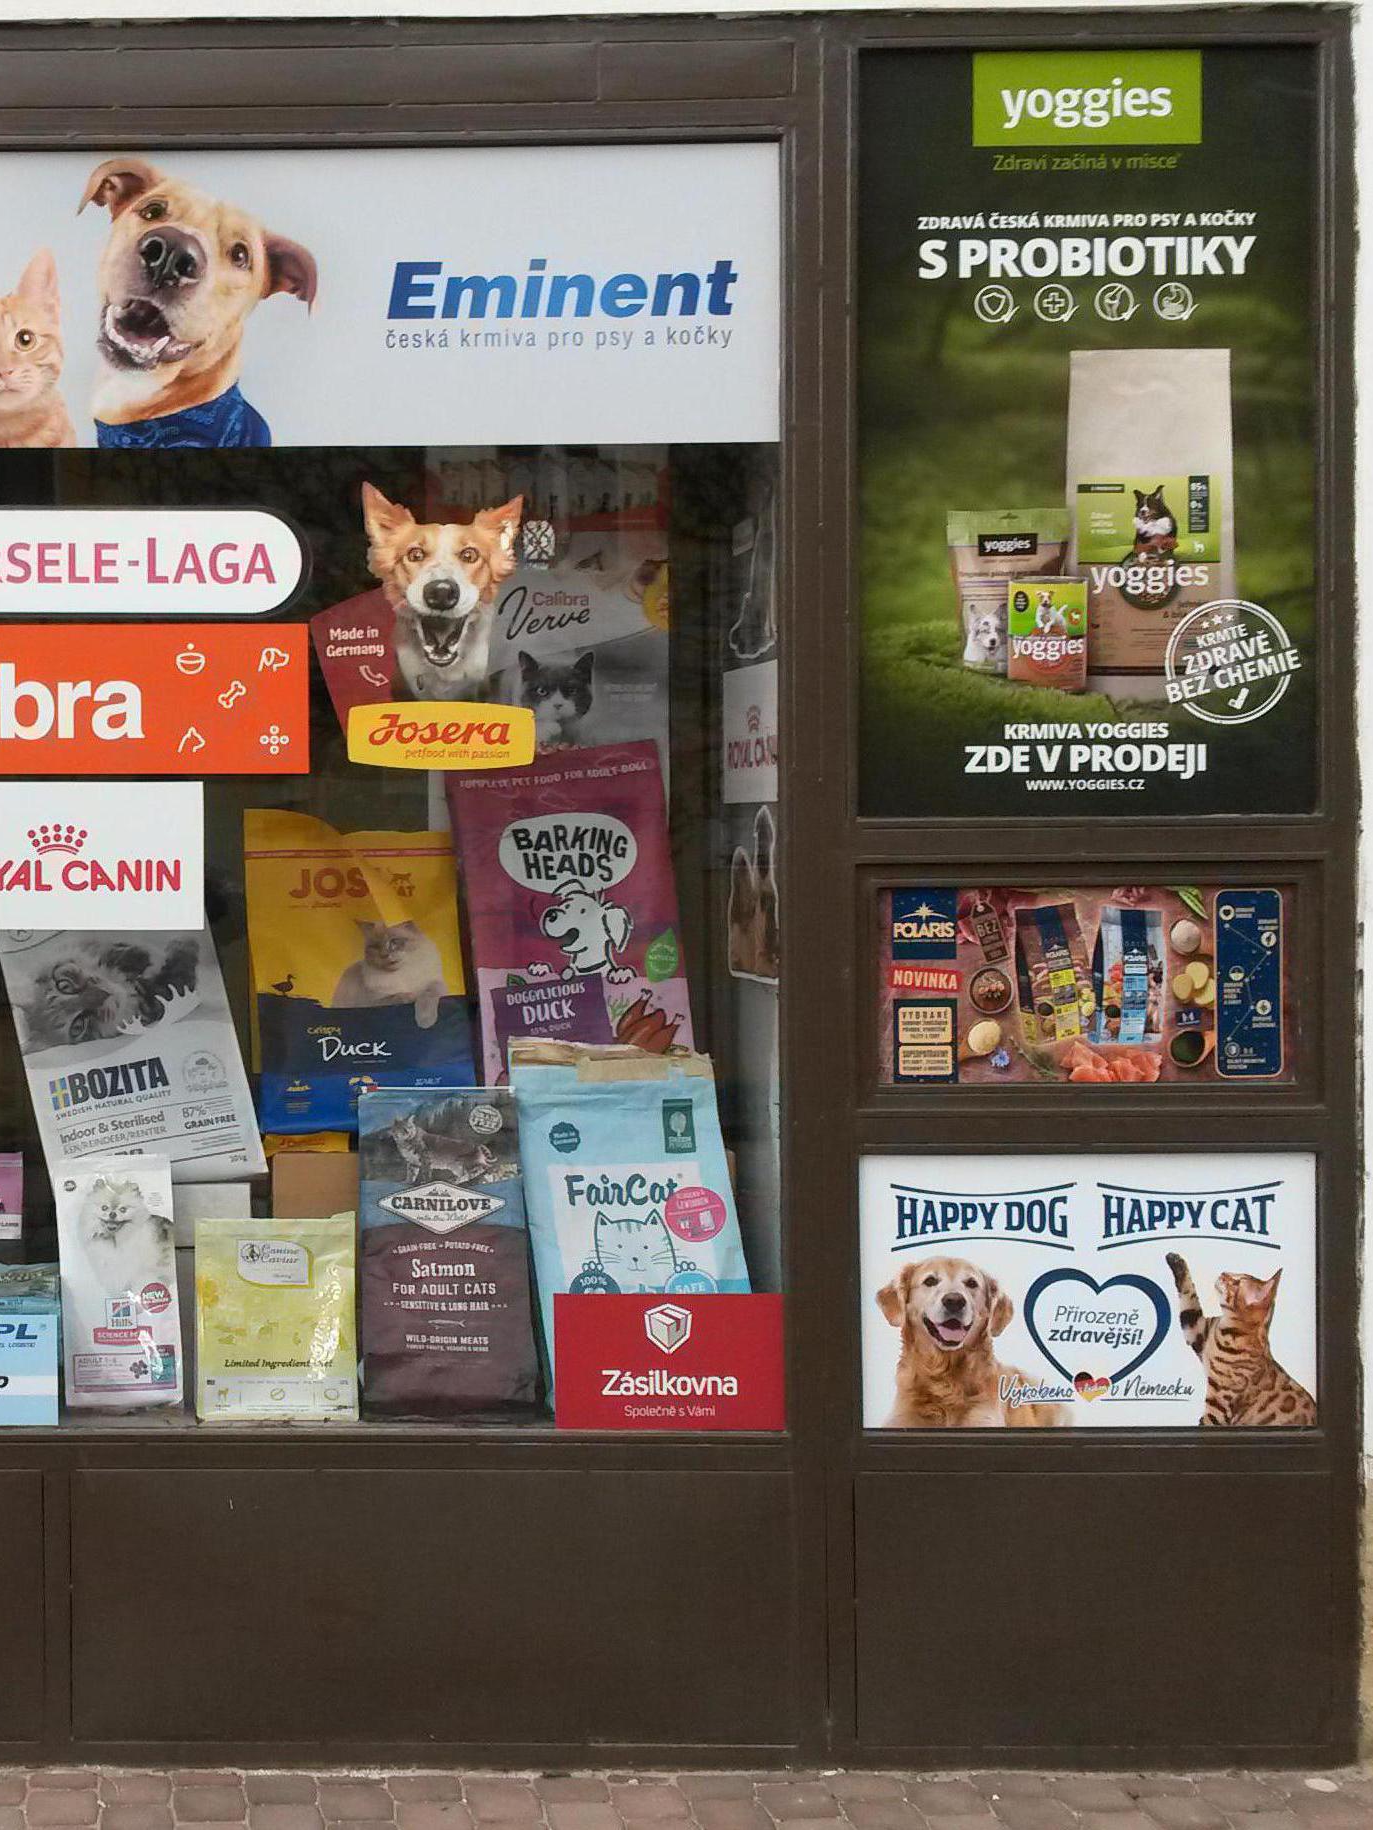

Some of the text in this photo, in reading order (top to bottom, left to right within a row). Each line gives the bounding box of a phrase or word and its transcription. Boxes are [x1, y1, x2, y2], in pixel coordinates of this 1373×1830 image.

[1001, 77, 1173, 129] yoggies
[992, 153, 1047, 171] Zdraví
[1052, 153, 1106, 170] začíná
[1111, 157, 1122, 169] v
[917, 210, 1257, 230] ZDRAVÁ ČESKÁ KRMIVA PRO PSY A KOČKY
[918, 236, 1257, 279] S PROBIOTIKY
[387, 259, 738, 319] Eminent
[386, 325, 733, 351] česká krmiva pro psy a kočky
[984, 537, 1031, 552] yoggies
[1090, 559, 1209, 594] yoggies
[532, 591, 590, 607] Calibra
[497, 586, 591, 640] Verve
[329, 626, 379, 640] Made in
[1196, 624, 1248, 649] KRMTE
[326, 642, 385, 658] Germany
[1012, 635, 1084, 661] yoggies
[1182, 631, 1273, 676] ZDRAVĚ
[1165, 649, 1302, 704] BEZ CHEMIE
[369, 713, 510, 746] Josera
[1004, 723, 1169, 739] KRMIVA YOGGIES
[404, 747, 510, 761] petfood with passion
[964, 743, 1207, 780] ZDE V PRODEJI
[1026, 779, 1145, 791] WWW.YOGGIES.CZ
[512, 825, 628, 858] BARKING
[61, 860, 181, 892] CANIN
[522, 853, 614, 882] HEADS
[893, 922, 955, 938] POLARIS
[893, 970, 958, 990] NOVINKA
[506, 982, 585, 1006] DOGGYLICIOUS
[522, 999, 576, 1025] DUCK
[67, 1056, 170, 1105] BOZITA
[95, 1097, 134, 1112] NATURAL
[135, 1089, 172, 1103] QUALITY
[60, 1126, 97, 1145] Indoor
[98, 1122, 109, 1134] &
[110, 1110, 165, 1131] Sterilised
[564, 1173, 678, 1206] FairCat
[391, 1196, 491, 1211] CARNILOVE
[1103, 1193, 1276, 1238] HAPPY CAT
[896, 1195, 1068, 1239] HAPPY DOG
[411, 1258, 476, 1278] Salmon
[393, 1283, 496, 1296] FOR ADULT CATS
[579, 1276, 608, 1287] 100%
[142, 1290, 165, 1299] NEW
[1054, 1304, 1140, 1326] Přirozeně
[460, 1336, 489, 1345] MEATS
[1048, 1326, 1143, 1347] zdravější!
[225, 1358, 260, 1368] Limited
[261, 1358, 310, 1370] Ingredient
[601, 1369, 738, 1396] Zásilkovna
[999, 1375, 1074, 1407] Vyrobeno
[624, 1404, 716, 1418] Společně s Vámi
